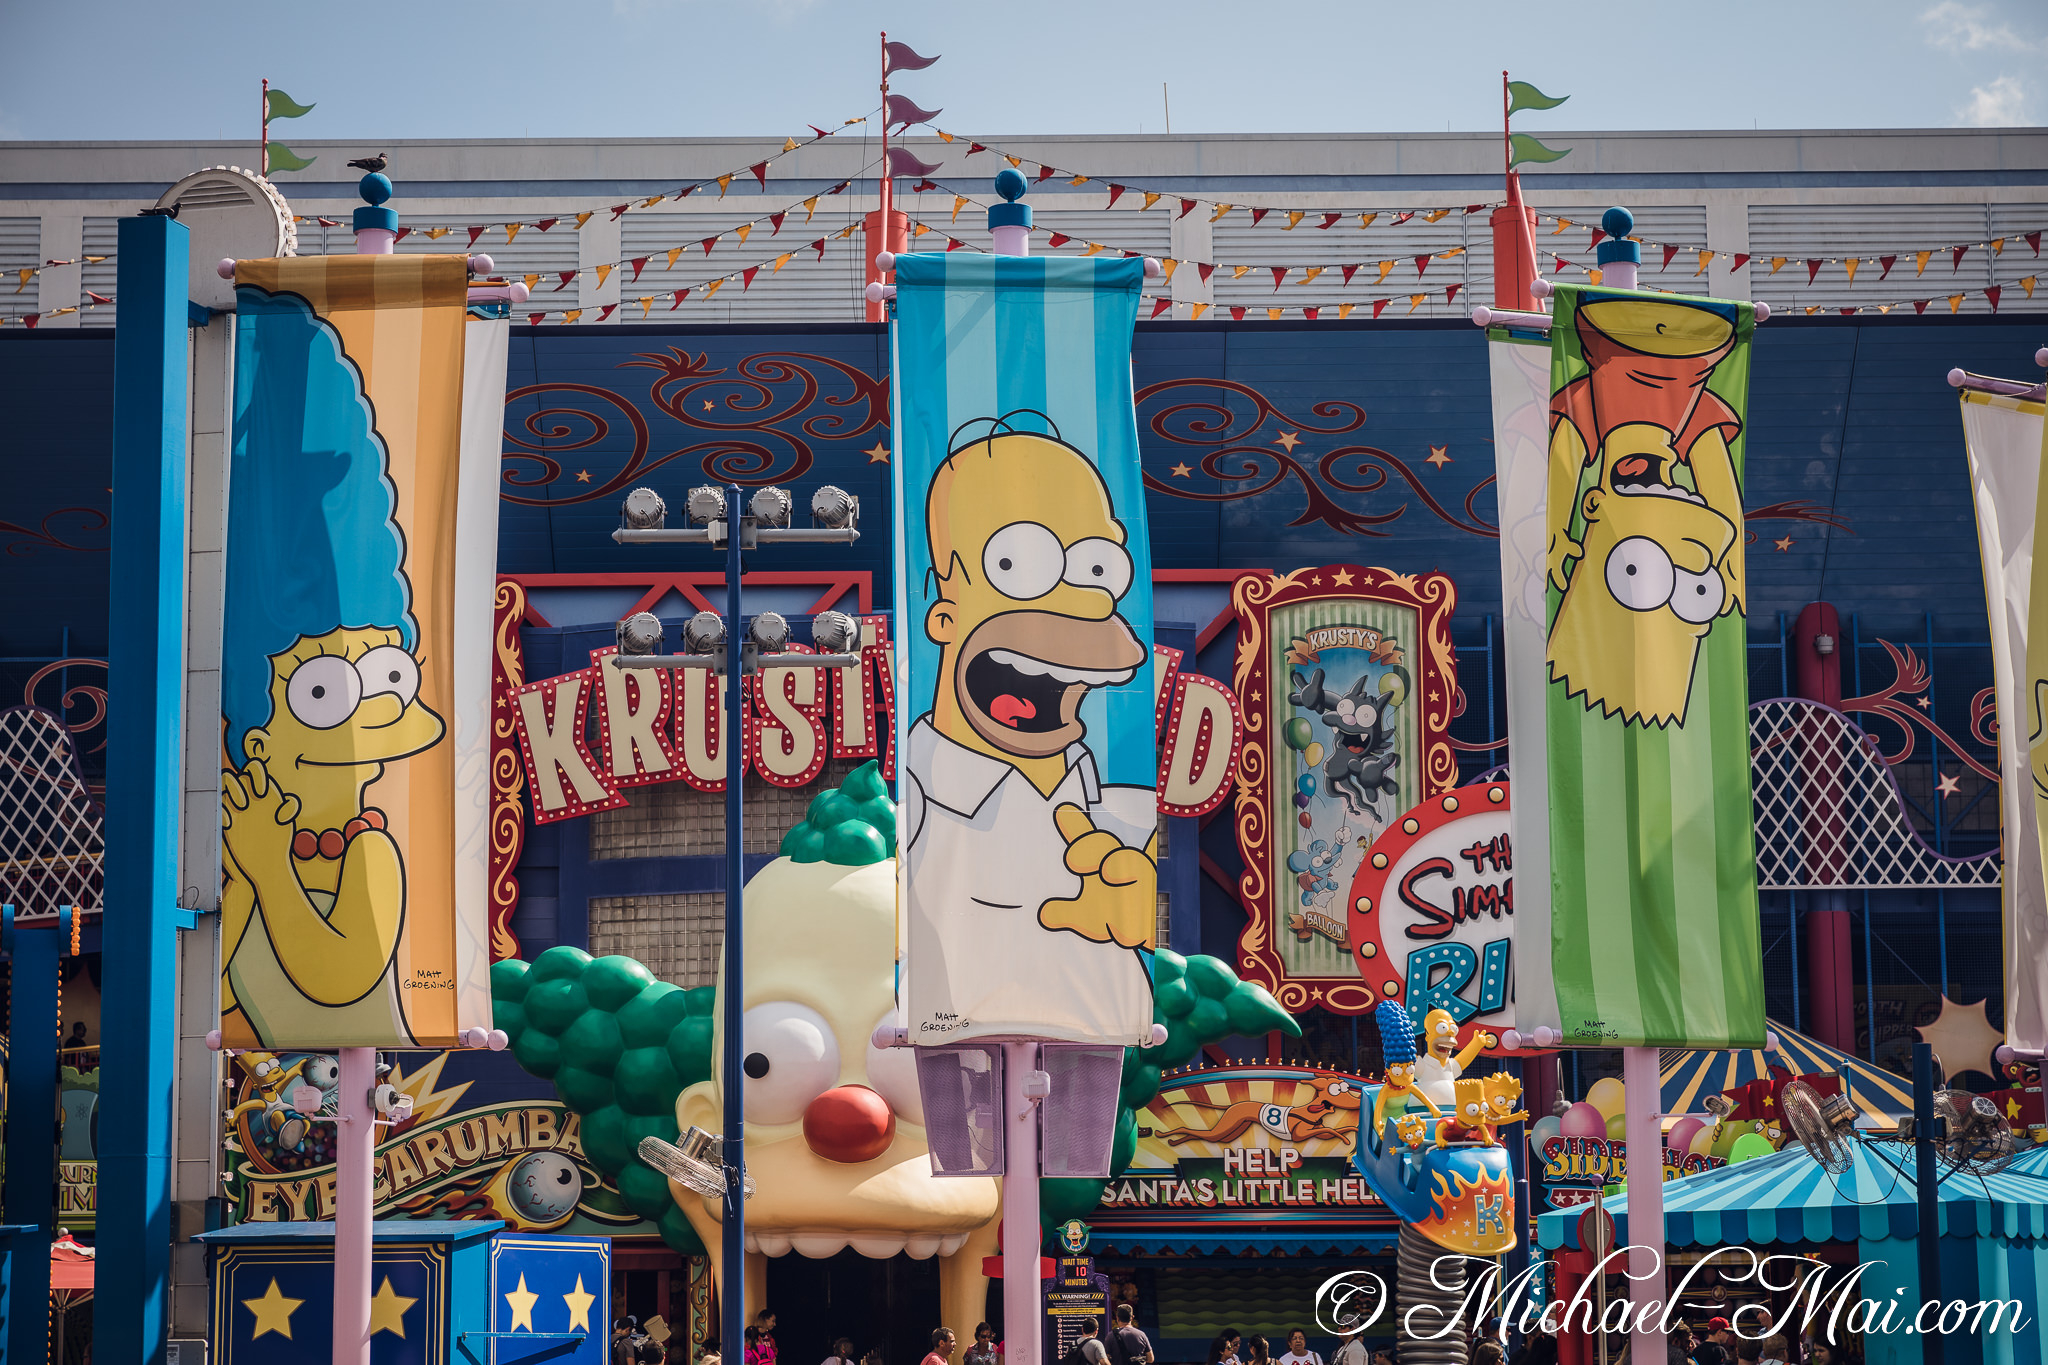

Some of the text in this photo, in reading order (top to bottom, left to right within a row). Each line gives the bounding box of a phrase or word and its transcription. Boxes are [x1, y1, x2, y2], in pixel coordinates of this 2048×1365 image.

[1309, 628, 1378, 651] KRUSTY'S
[1460, 833, 1512, 874] TH
[1307, 913, 1344, 940] BALLOON
[403, 979, 455, 990] GROENING
[1405, 937, 1515, 1036] RI
[1574, 1027, 1619, 1040] GROENING
[1266, 1107, 1281, 1127] 8
[1223, 1147, 1302, 1178] HELP
[244, 1173, 338, 1223] EYE
[1100, 1178, 1382, 1207] SANTA'S LITTLE HEL
[1474, 1193, 1505, 1236] K
[1062, 1258, 1089, 1266] WAIT TIME
[1075, 1266, 1087, 1277] 10
[1064, 1278, 1088, 1287] MINUTES
